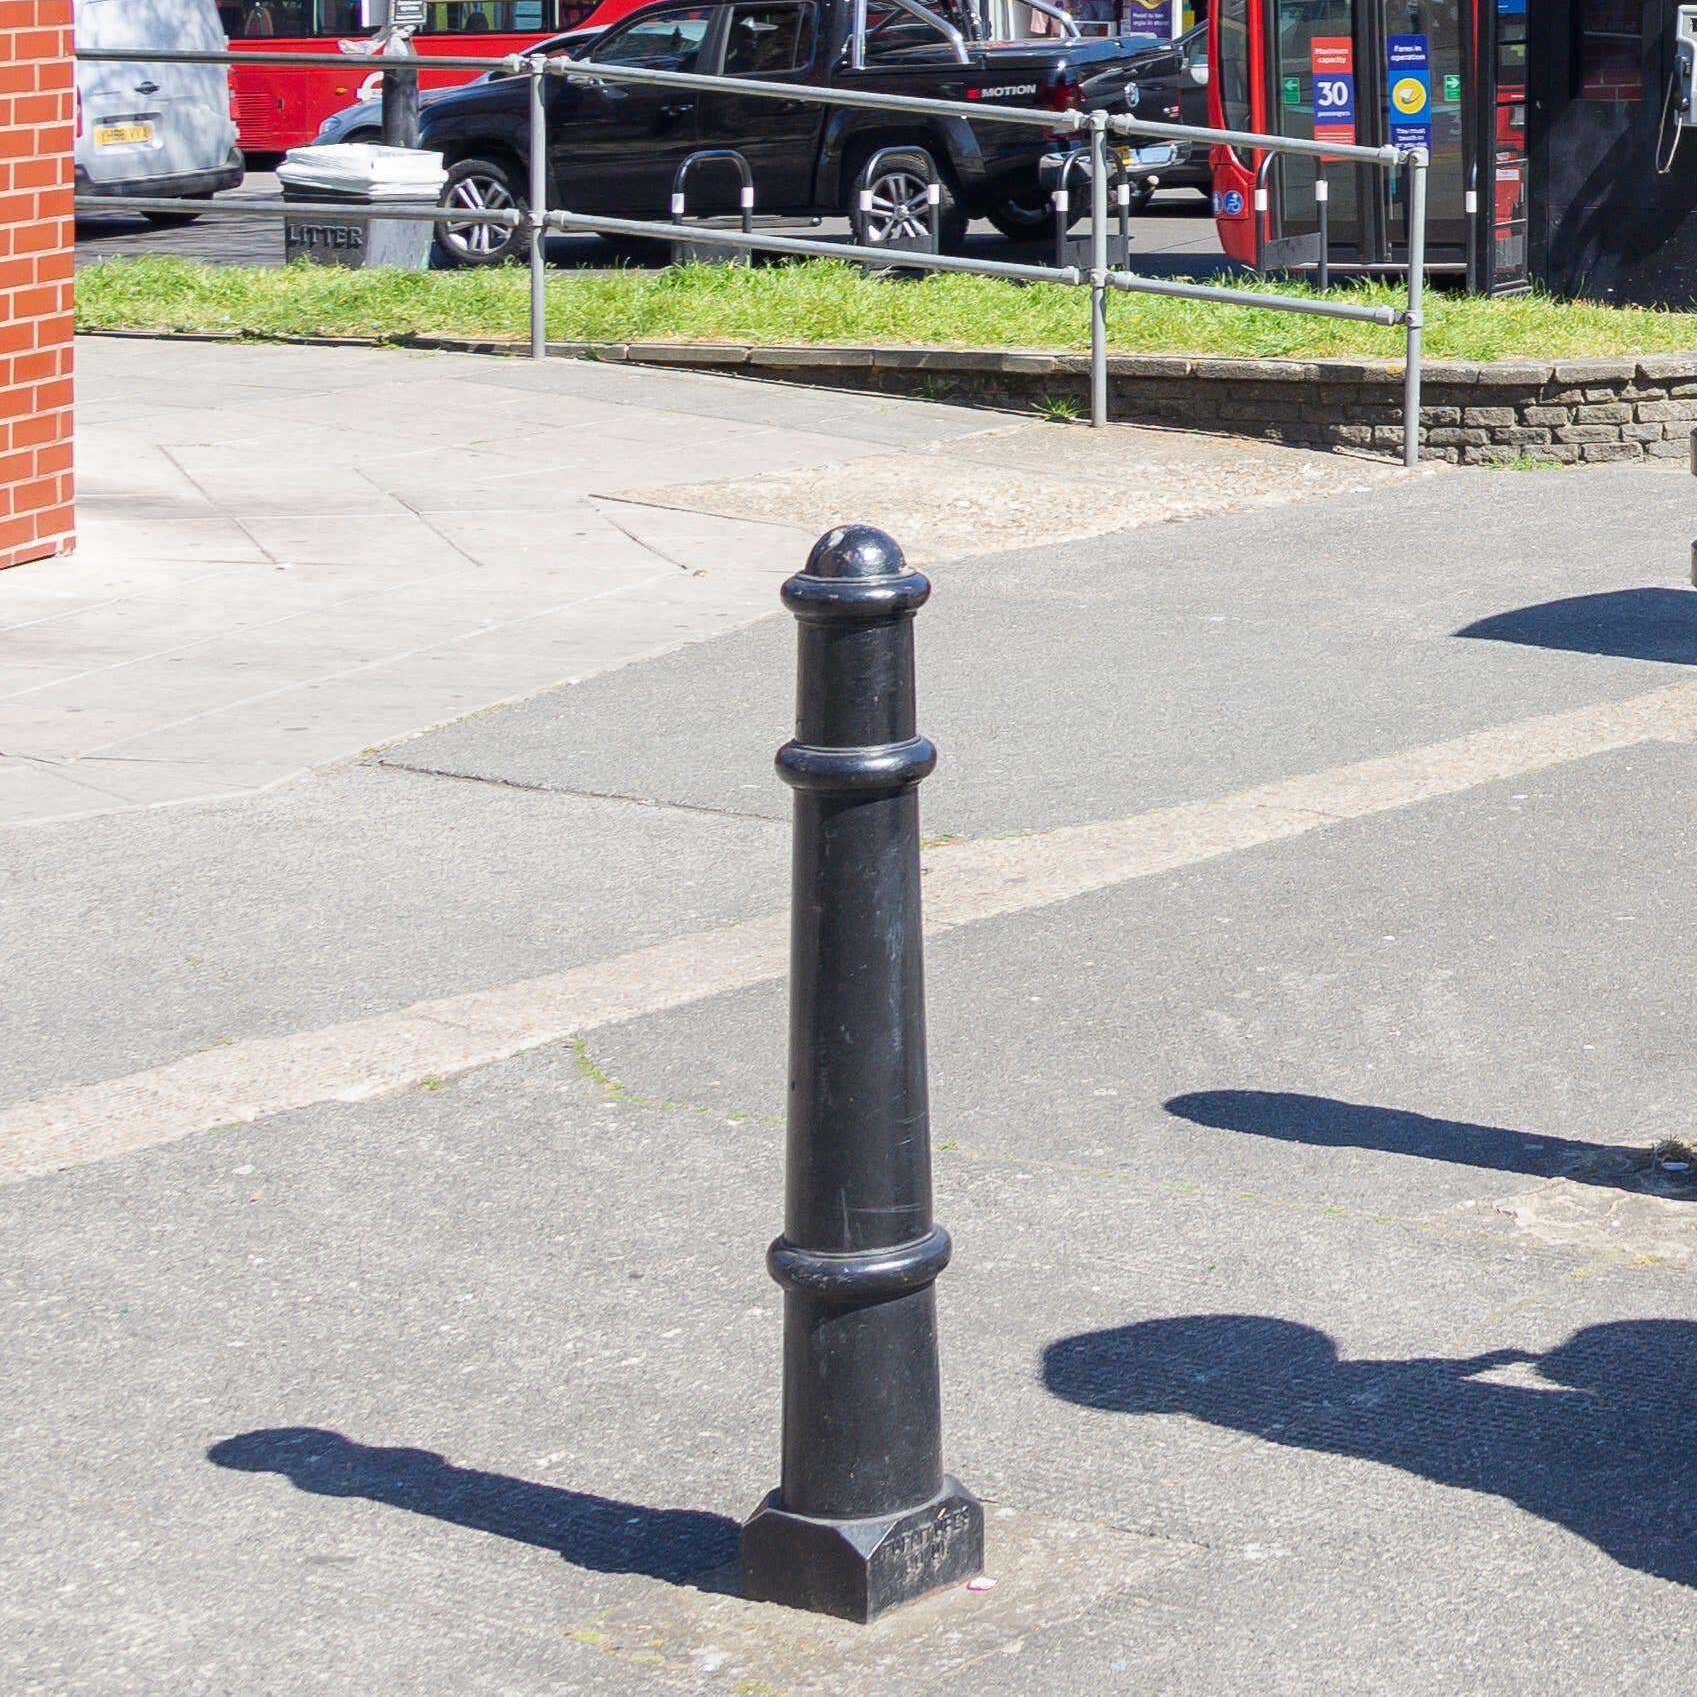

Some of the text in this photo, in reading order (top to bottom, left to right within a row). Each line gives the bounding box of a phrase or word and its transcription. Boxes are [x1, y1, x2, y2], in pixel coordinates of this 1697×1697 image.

[1316, 56, 1347, 64] capacity
[1317, 81, 1349, 107] 30
[288, 223, 364, 247] LITTER
